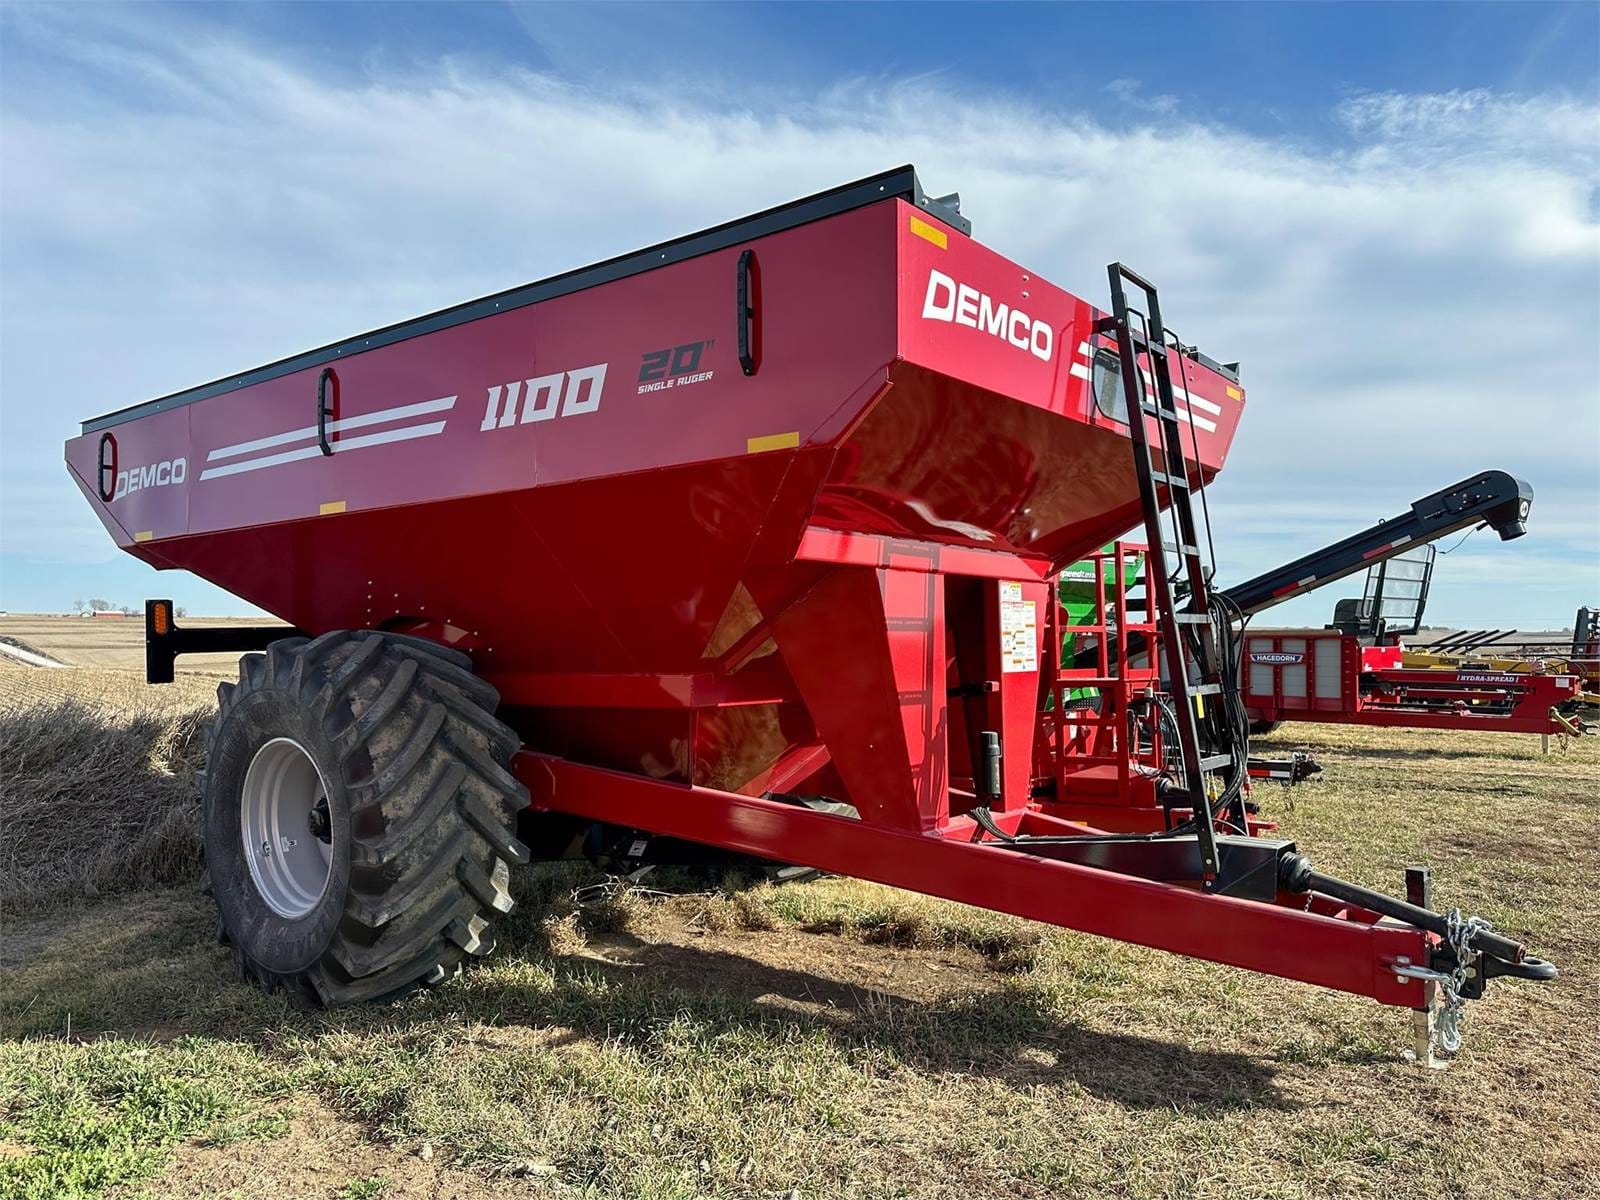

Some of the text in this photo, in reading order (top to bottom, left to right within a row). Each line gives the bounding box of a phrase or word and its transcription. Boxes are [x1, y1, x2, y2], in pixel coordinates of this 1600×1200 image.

[922, 268, 1053, 362] DEMCO
[480, 363, 608, 432] 1100
[637, 370, 714, 395] SINGLE AUGER
[112, 457, 187, 501] DEMCO
